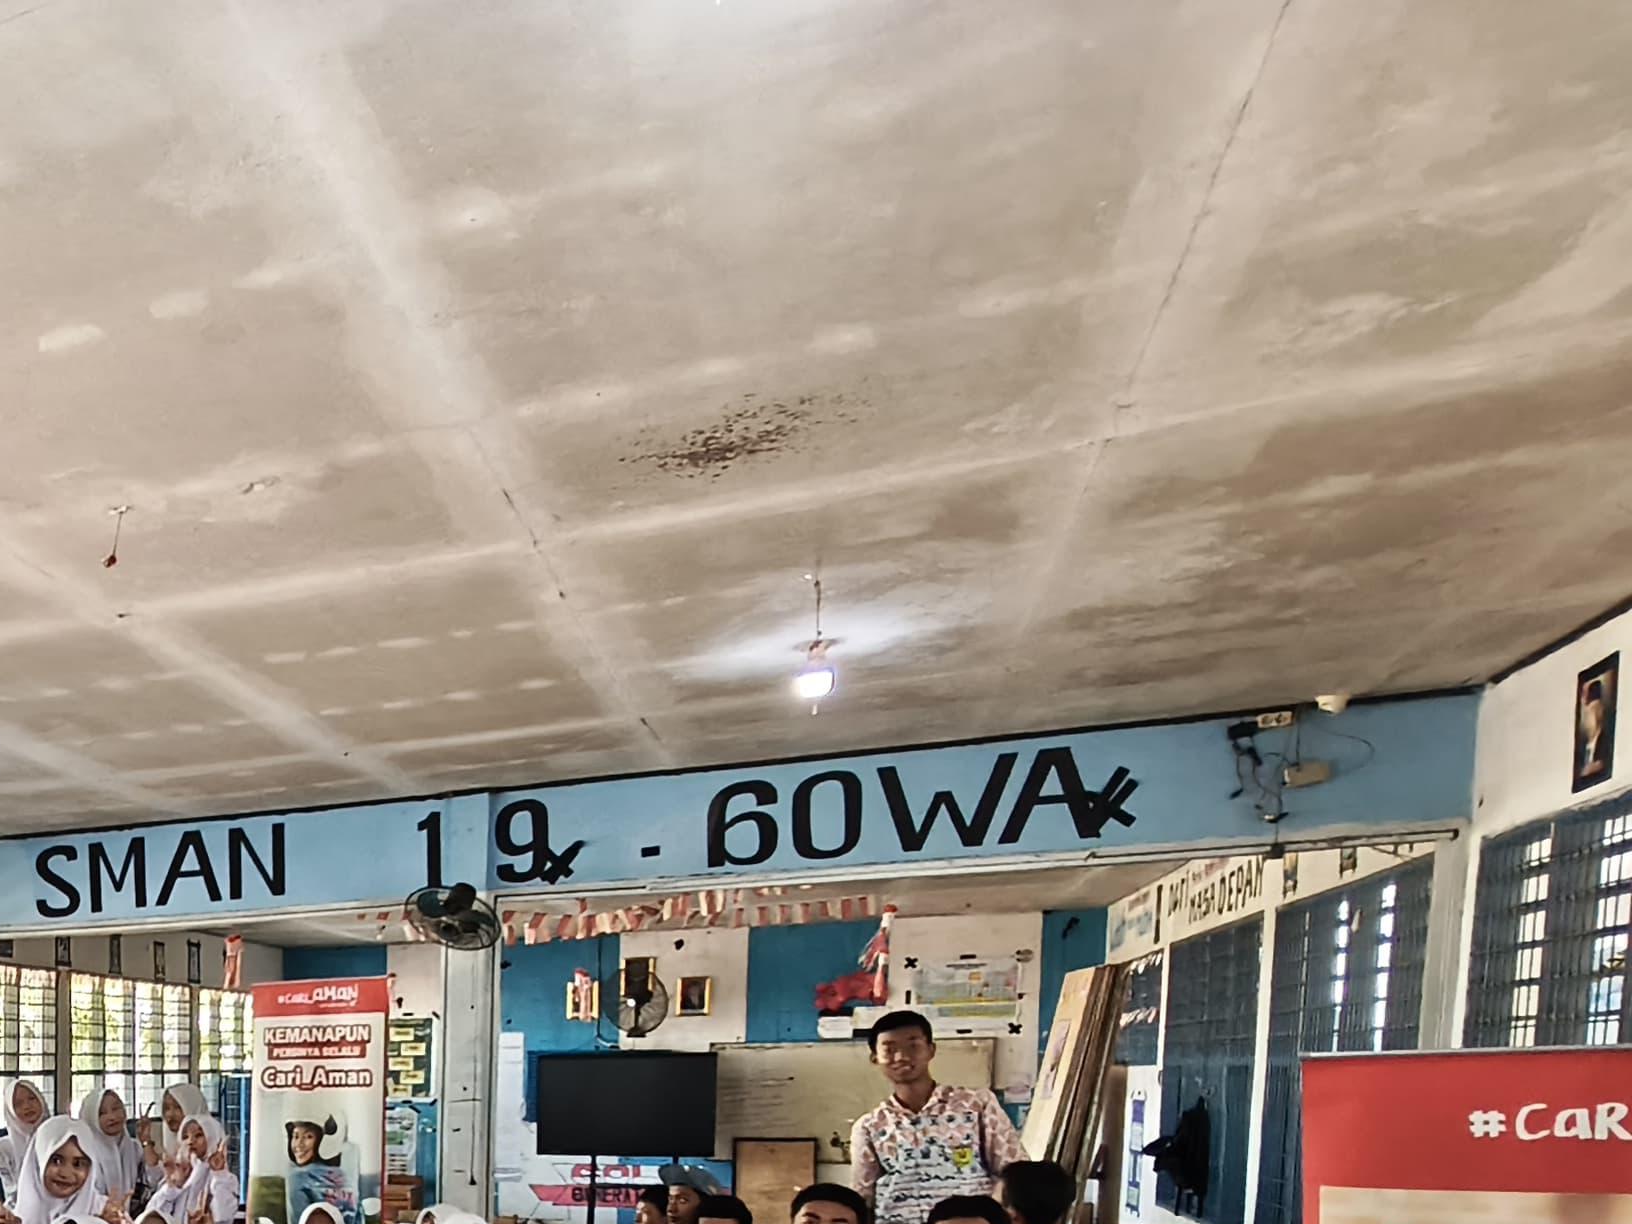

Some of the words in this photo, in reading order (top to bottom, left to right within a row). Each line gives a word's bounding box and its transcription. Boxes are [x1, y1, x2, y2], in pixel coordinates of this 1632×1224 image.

[35, 822, 286, 918] SMAN
[1218, 856, 1265, 915] DEPAN
[264, 1025, 370, 1043] KEMANAPUN
[262, 1066, 371, 1089] Cari_Aman
